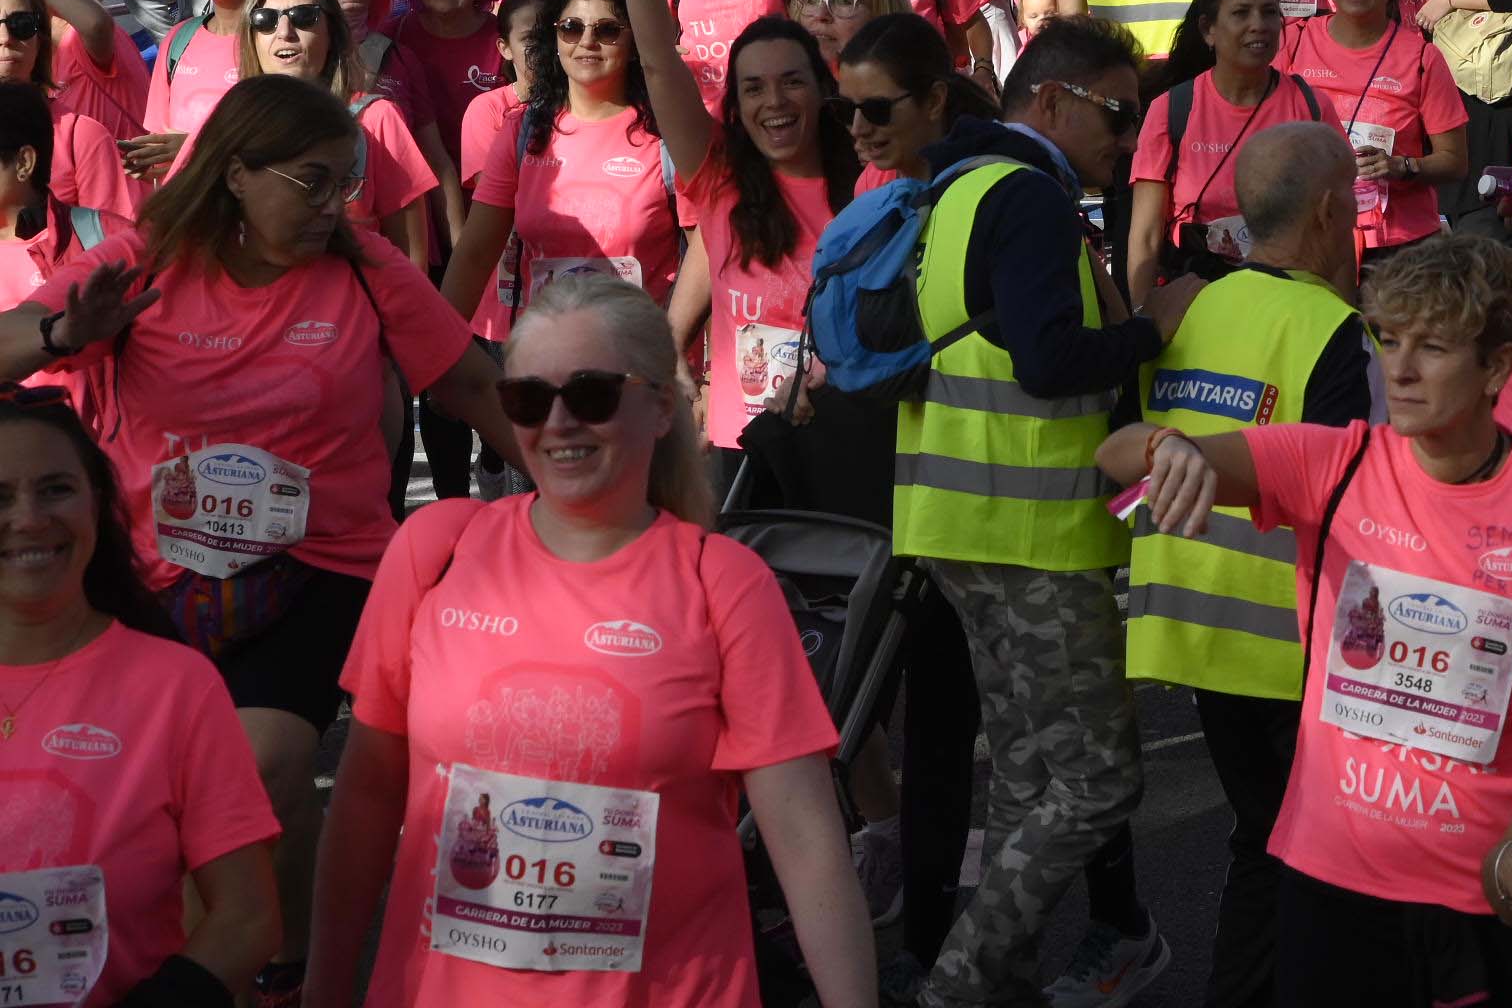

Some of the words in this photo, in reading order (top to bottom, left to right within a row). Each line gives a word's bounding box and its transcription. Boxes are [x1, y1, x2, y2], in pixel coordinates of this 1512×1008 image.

[689, 19, 714, 37] TU
[728, 289, 762, 321] TU
[178, 331, 243, 351] OYSHO
[203, 463, 261, 481] ASTURIANA
[201, 494, 254, 518] 016
[206, 520, 245, 537] 10413
[1359, 518, 1426, 552] OYSHO
[171, 529, 207, 546] CARRERA
[207, 537, 219, 547] DE
[220, 539, 232, 550] LA
[233, 541, 264, 553] MUJER
[169, 543, 206, 565] OYSHO
[441, 607, 518, 637] OYSHO
[1393, 602, 1462, 631] ASTURIANA
[1475, 614, 1512, 631] SUMA
[590, 631, 656, 651] ASTURIANA
[1389, 641, 1450, 674] 016
[1394, 672, 1433, 694] 3548
[1340, 682, 1388, 702] CARRERA
[1390, 693, 1405, 706] DE
[1407, 696, 1420, 709] LA
[1422, 700, 1457, 718] MUJER
[1460, 709, 1485, 725] 2023
[1335, 703, 1384, 728] OYSHO
[1428, 727, 1484, 750] Santander
[1340, 756, 1461, 819] SUMA
[505, 809, 586, 836] ASTURIANA
[602, 815, 641, 830] SUMA
[1440, 823, 1465, 834] 2023
[505, 854, 576, 888] 016
[46, 894, 88, 907] SUMA
[513, 891, 558, 910] 6177
[455, 904, 508, 924] CARRERA
[512, 916, 527, 927] DE
[531, 918, 547, 929] LA
[549, 919, 592, 930] MUJER
[449, 928, 507, 954] OYSHO
[559, 943, 625, 958] Santander
